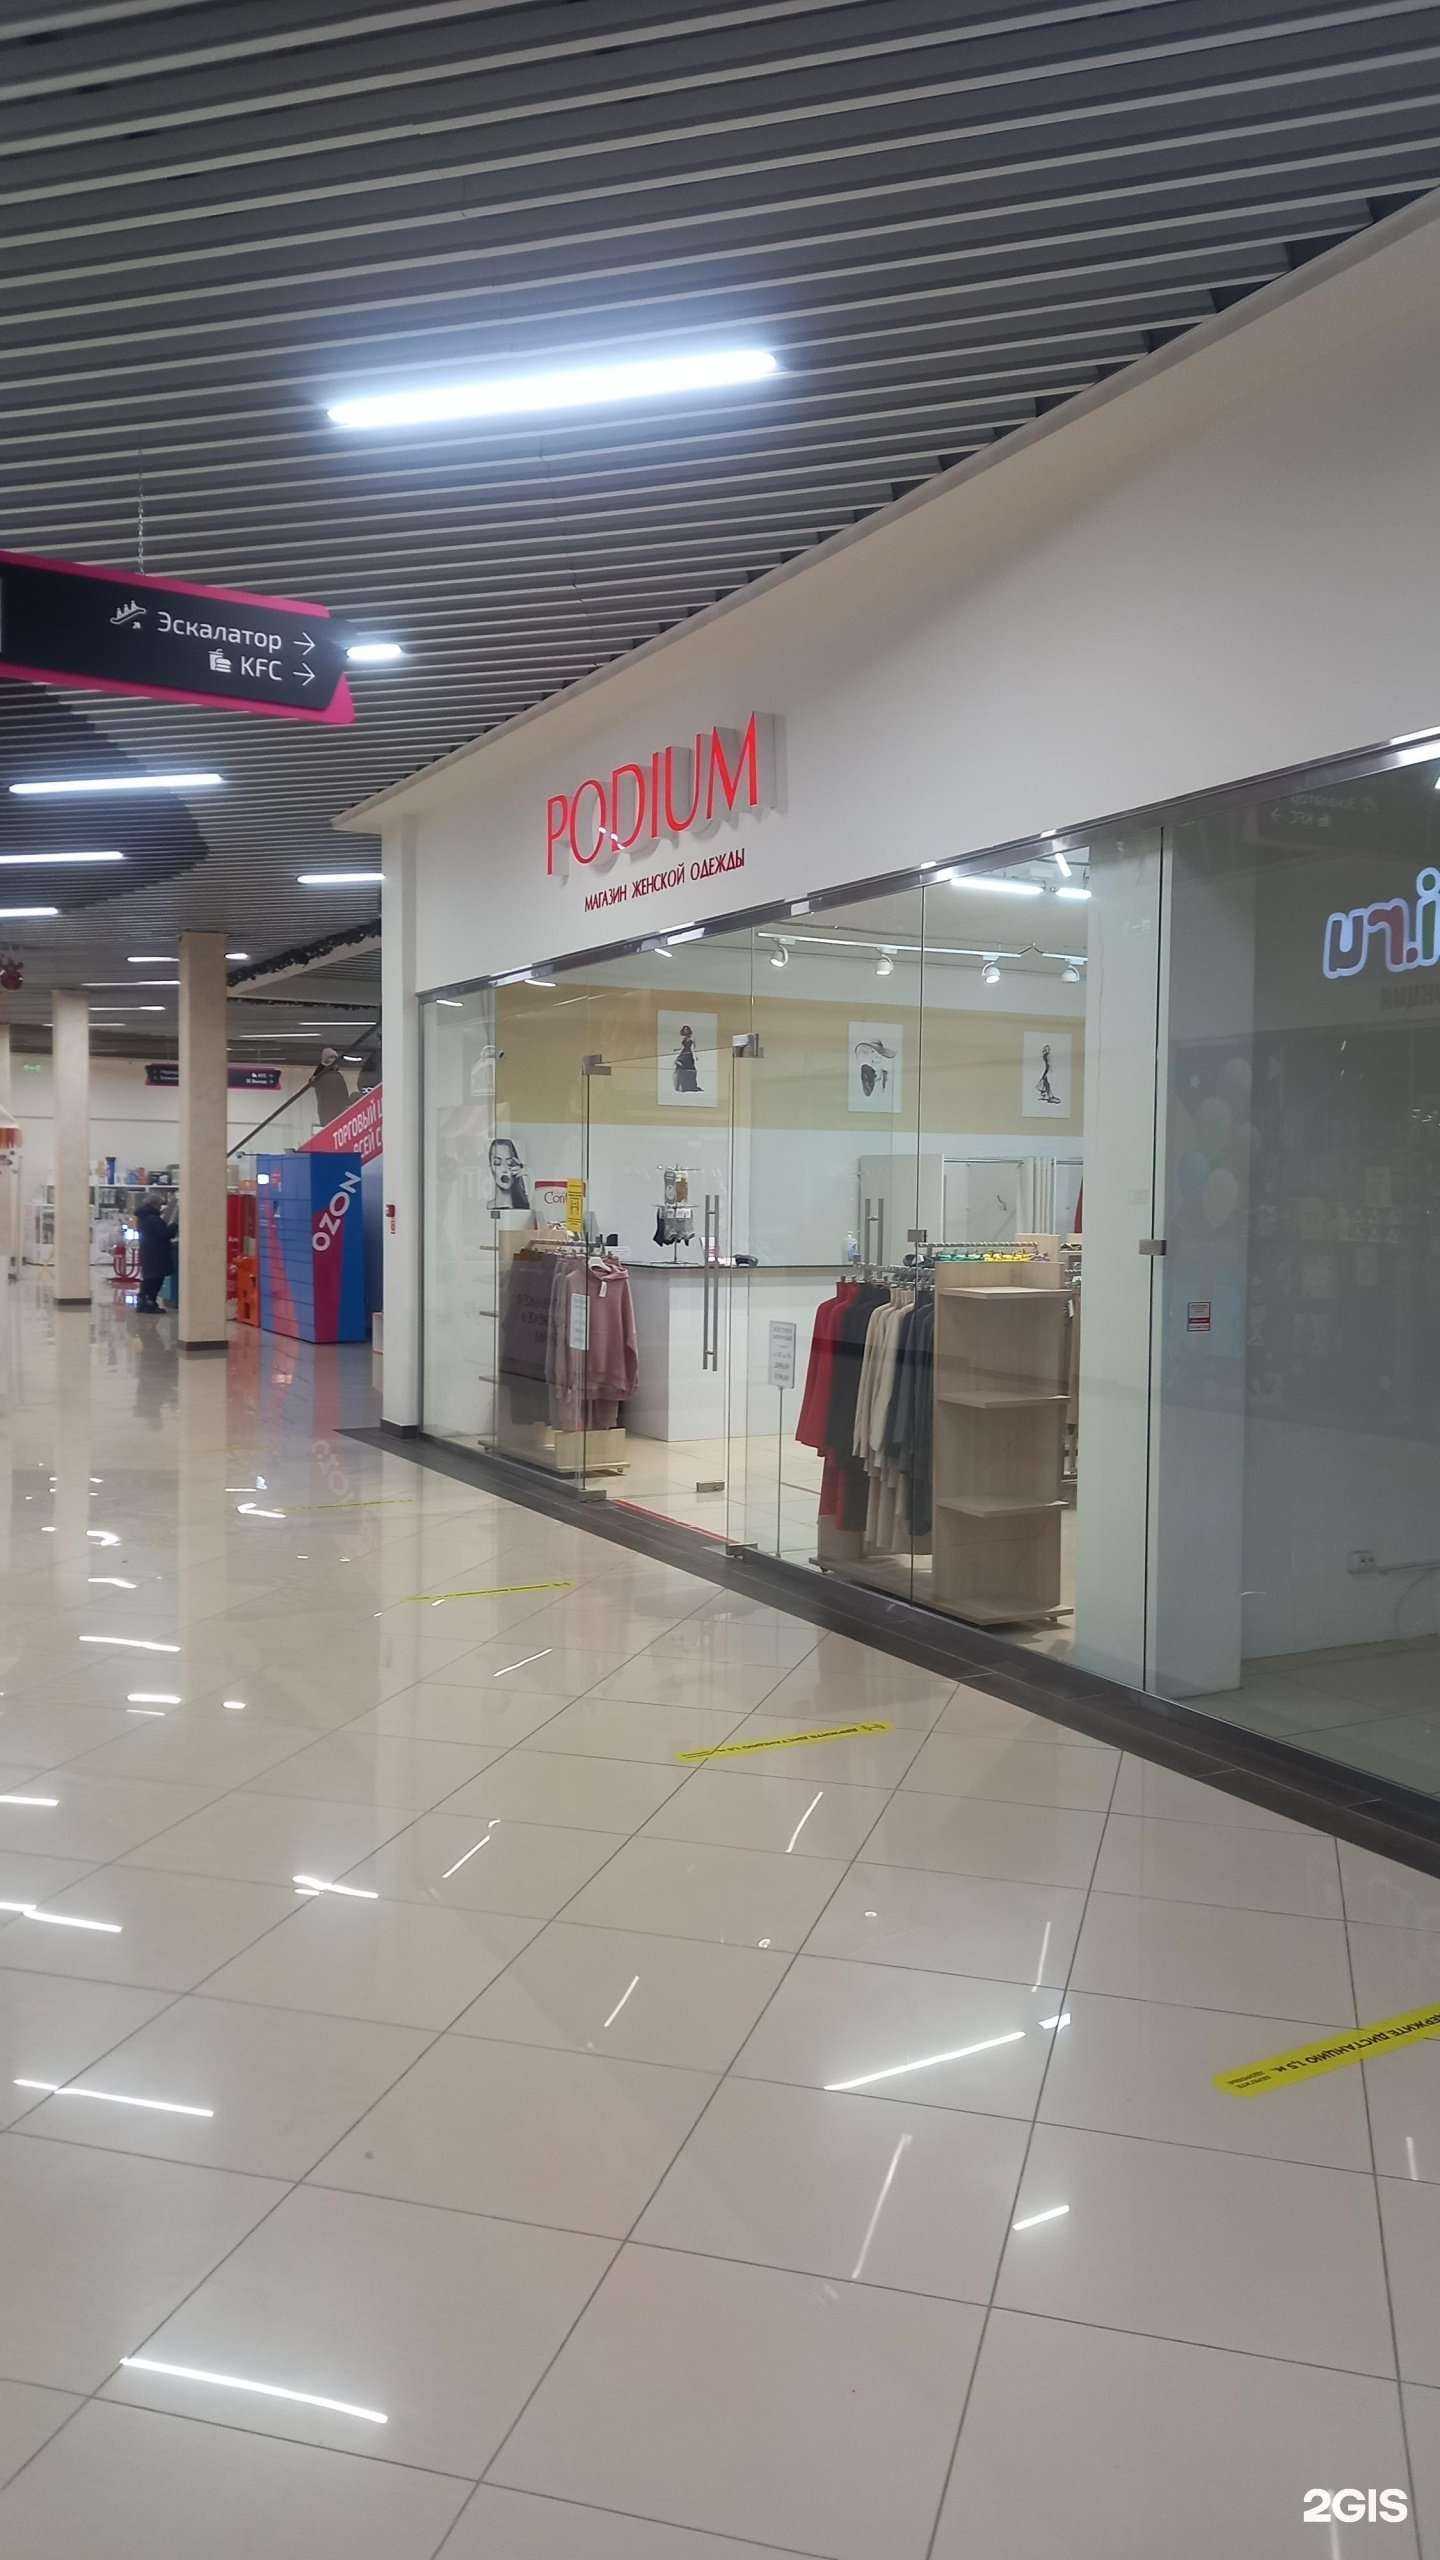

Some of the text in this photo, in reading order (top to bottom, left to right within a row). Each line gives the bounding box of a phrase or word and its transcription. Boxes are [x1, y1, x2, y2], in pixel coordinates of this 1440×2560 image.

[157, 611, 282, 653] Эскалатор
[241, 655, 282, 680] KFC
[547, 711, 758, 875] PODIUM
[585, 848, 745, 912] МАГАЗИН ЖЕНСКОЙ ОДЕЖДЫ
[332, 1099, 377, 1150] ТОРГОВЫЙ
[312, 1171, 361, 1251] OZON
[1305, 2032, 1390, 2064] ДИСТАНЦИЮ
